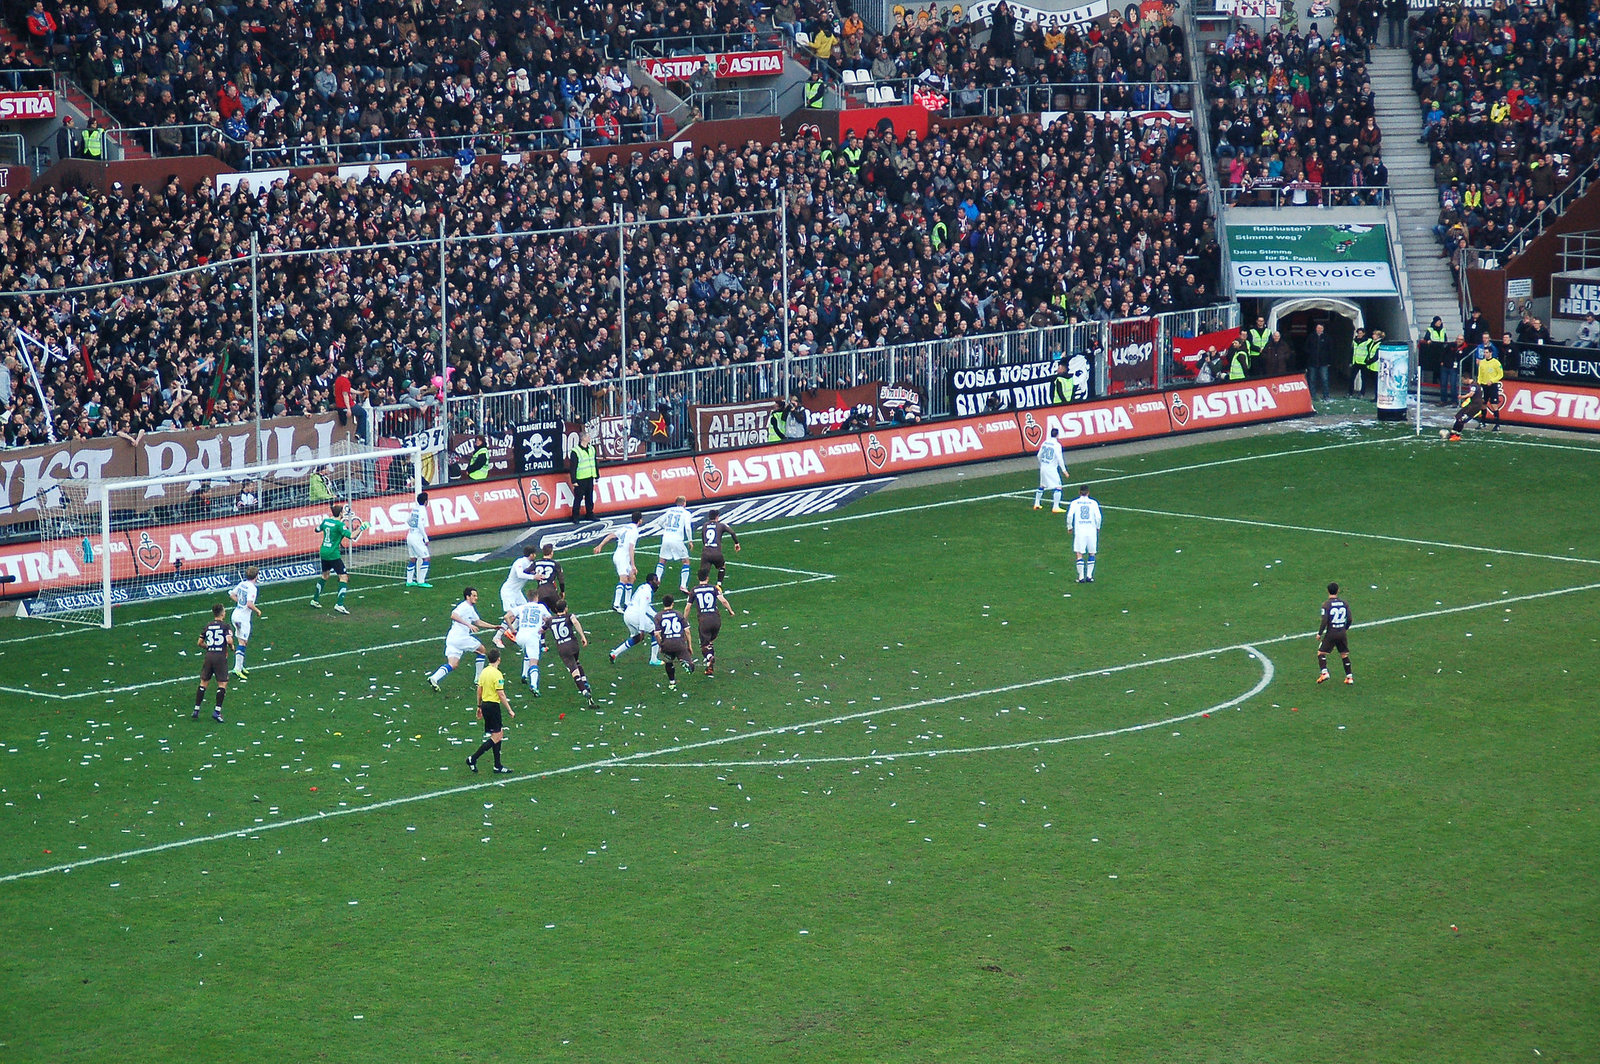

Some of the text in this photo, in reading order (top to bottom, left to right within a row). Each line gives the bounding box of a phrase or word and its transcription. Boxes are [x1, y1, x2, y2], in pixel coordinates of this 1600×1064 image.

[651, 60, 700, 78] ASTRA
[730, 55, 781, 73] ASTRA
[0, 97, 53, 115] STRA
[1240, 279, 1331, 287] Halstabletten
[1570, 284, 1600, 300] KIE
[953, 360, 1060, 390] COSA NOSTRA
[1549, 357, 1600, 379] RELEN
[956, 388, 1011, 416] SANT
[1192, 381, 1307, 420] ASTRA ASTRA
[1507, 389, 1600, 421] ASTR
[516, 421, 557, 434] STRAIGHT EDGE
[709, 410, 773, 434] ALERT
[1046, 400, 1167, 442] ASTRA ASTRA
[708, 430, 768, 449] NETWOR
[890, 419, 1017, 463] ASTRA ASTRA
[1042, 445, 1054, 460] 20
[727, 442, 861, 487] ASTRA ASTRA
[484, 488, 519, 503] ASTRA
[555, 466, 696, 510] ATRA ASTRA
[1080, 505, 1089, 520] 8
[169, 521, 288, 564] ASTRA
[705, 528, 716, 545] 9
[0, 548, 80, 584] TRA
[55, 589, 129, 610] RELENTESS
[145, 578, 192, 597] ENERGY
[192, 574, 232, 593] DRINK
[696, 592, 714, 610] 19
[521, 607, 541, 625] 15
[1329, 606, 1347, 624] 22
[551, 621, 570, 640] 16
[661, 616, 683, 635] 26
[205, 629, 225, 647] 35
